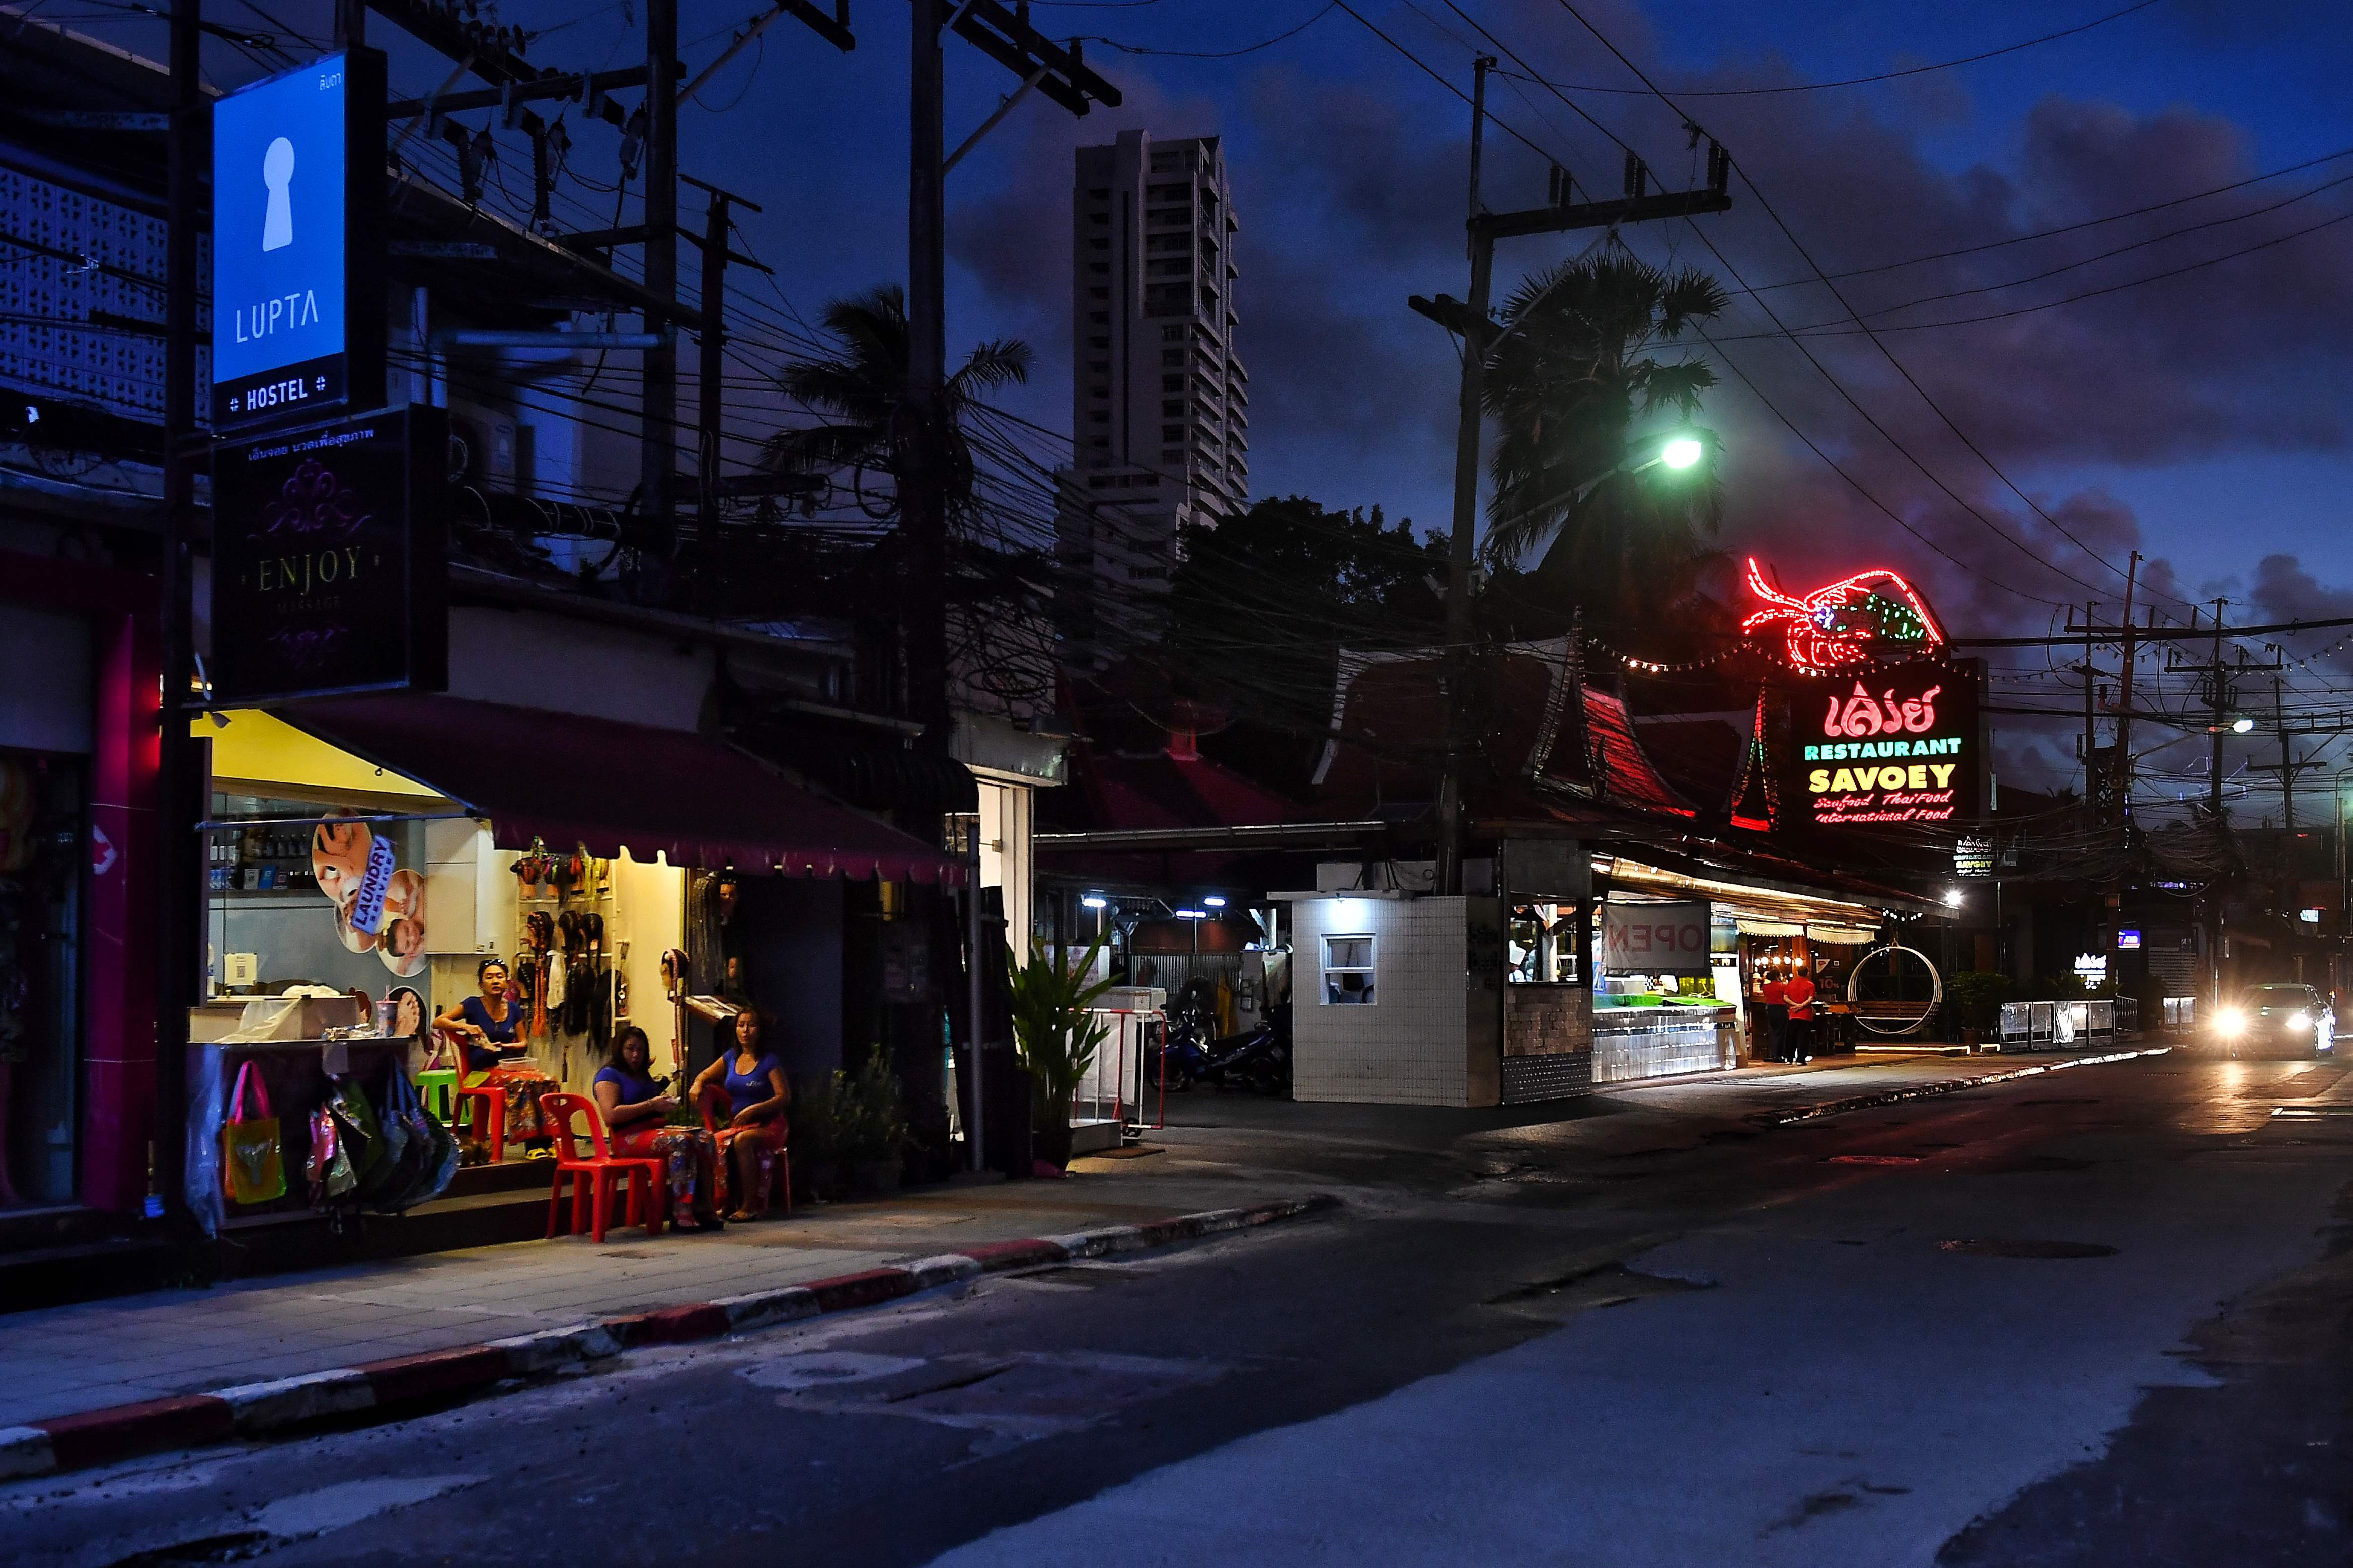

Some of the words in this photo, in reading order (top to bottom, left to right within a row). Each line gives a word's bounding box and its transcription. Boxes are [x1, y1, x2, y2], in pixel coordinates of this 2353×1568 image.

[236, 289, 319, 343] LUPTA
[247, 378, 308, 410] HOSTEL
[259, 545, 363, 596] ENJOY
[1805, 738, 1961, 761] RESTAURANT
[1809, 764, 1956, 793] SAVOEY
[1813, 793, 1874, 812] Seafood
[1882, 792, 1915, 805] Thai
[1915, 790, 1954, 804] Food
[1916, 806, 1954, 820] Food
[355, 841, 387, 925] LAUNDRY
